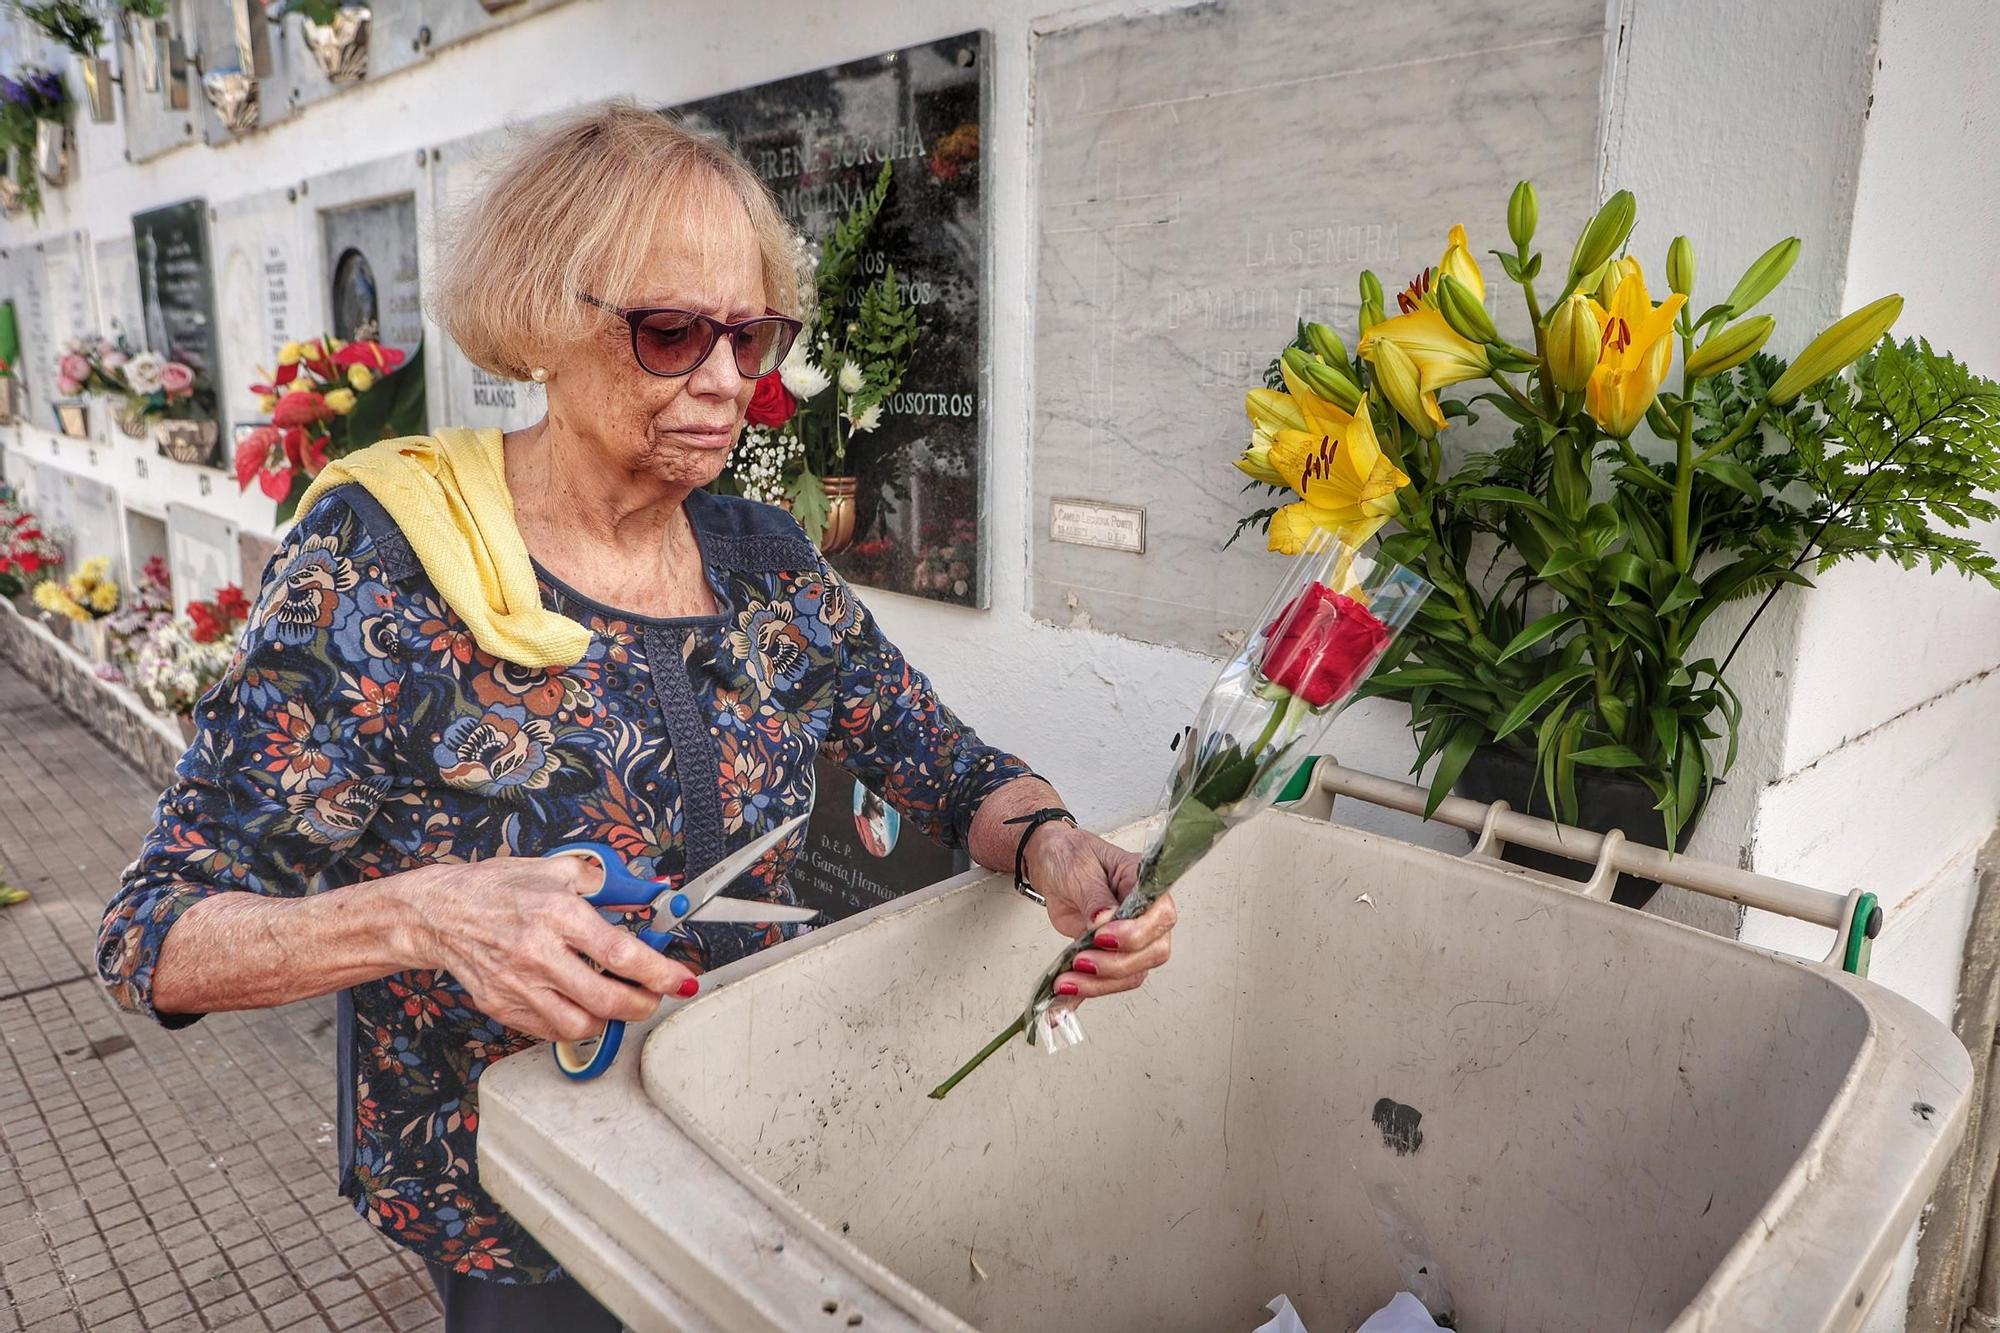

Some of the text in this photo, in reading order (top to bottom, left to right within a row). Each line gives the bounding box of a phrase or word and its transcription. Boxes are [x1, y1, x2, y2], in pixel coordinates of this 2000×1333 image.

[782, 177, 868, 218] MOLINA
[1246, 231, 1277, 267] LA
[883, 392, 973, 417] NOSOTROS
[812, 851, 849, 881] García
